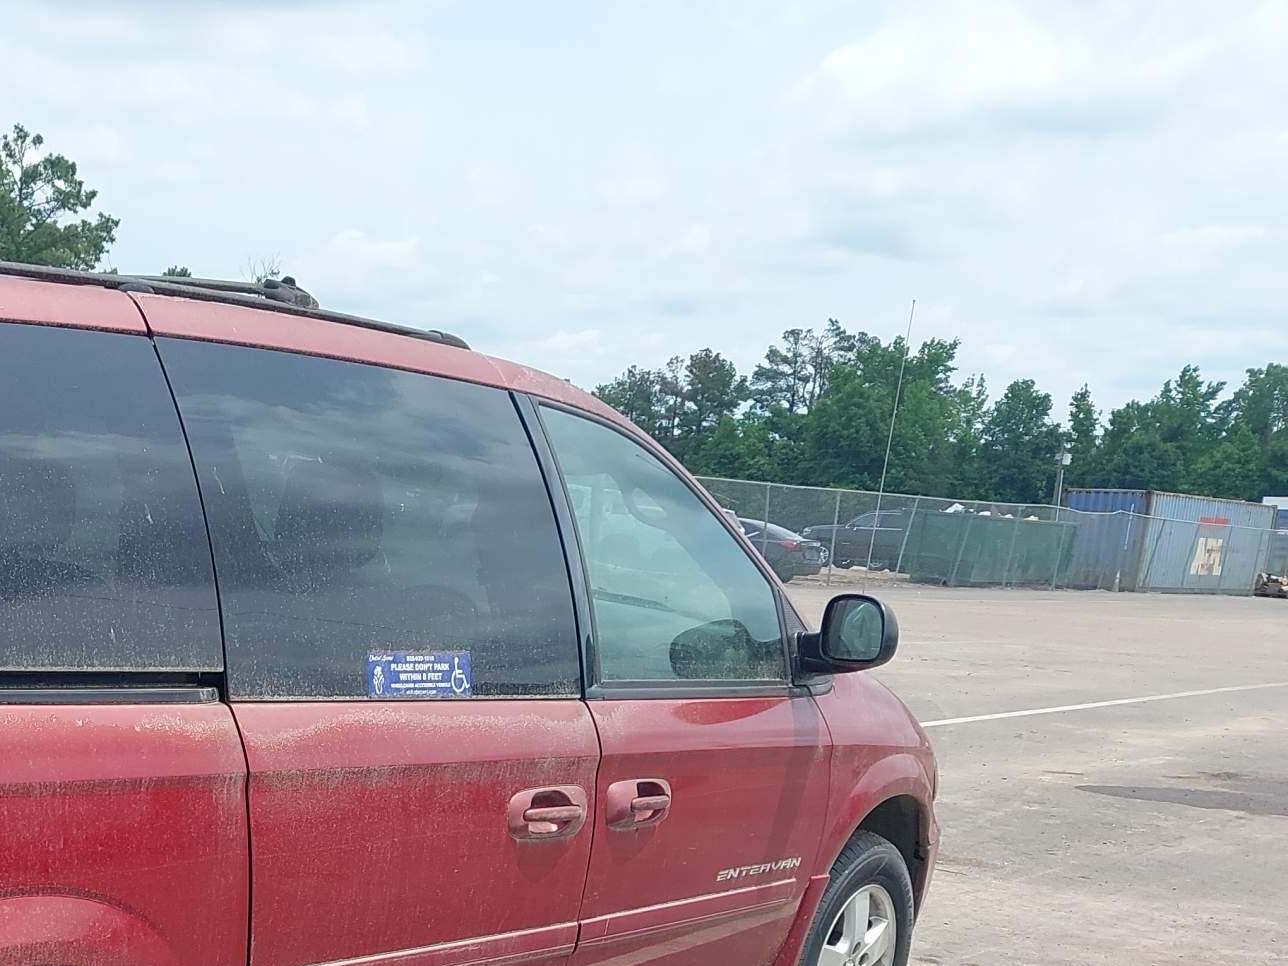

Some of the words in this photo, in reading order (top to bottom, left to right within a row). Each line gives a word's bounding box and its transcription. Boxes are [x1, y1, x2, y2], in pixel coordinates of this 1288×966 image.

[391, 663, 414, 671] PLEASE
[434, 663, 450, 671] PARK
[399, 672, 422, 681] WITHIN
[428, 672, 442, 681] FEET
[716, 857, 802, 882] ENTERVAN
